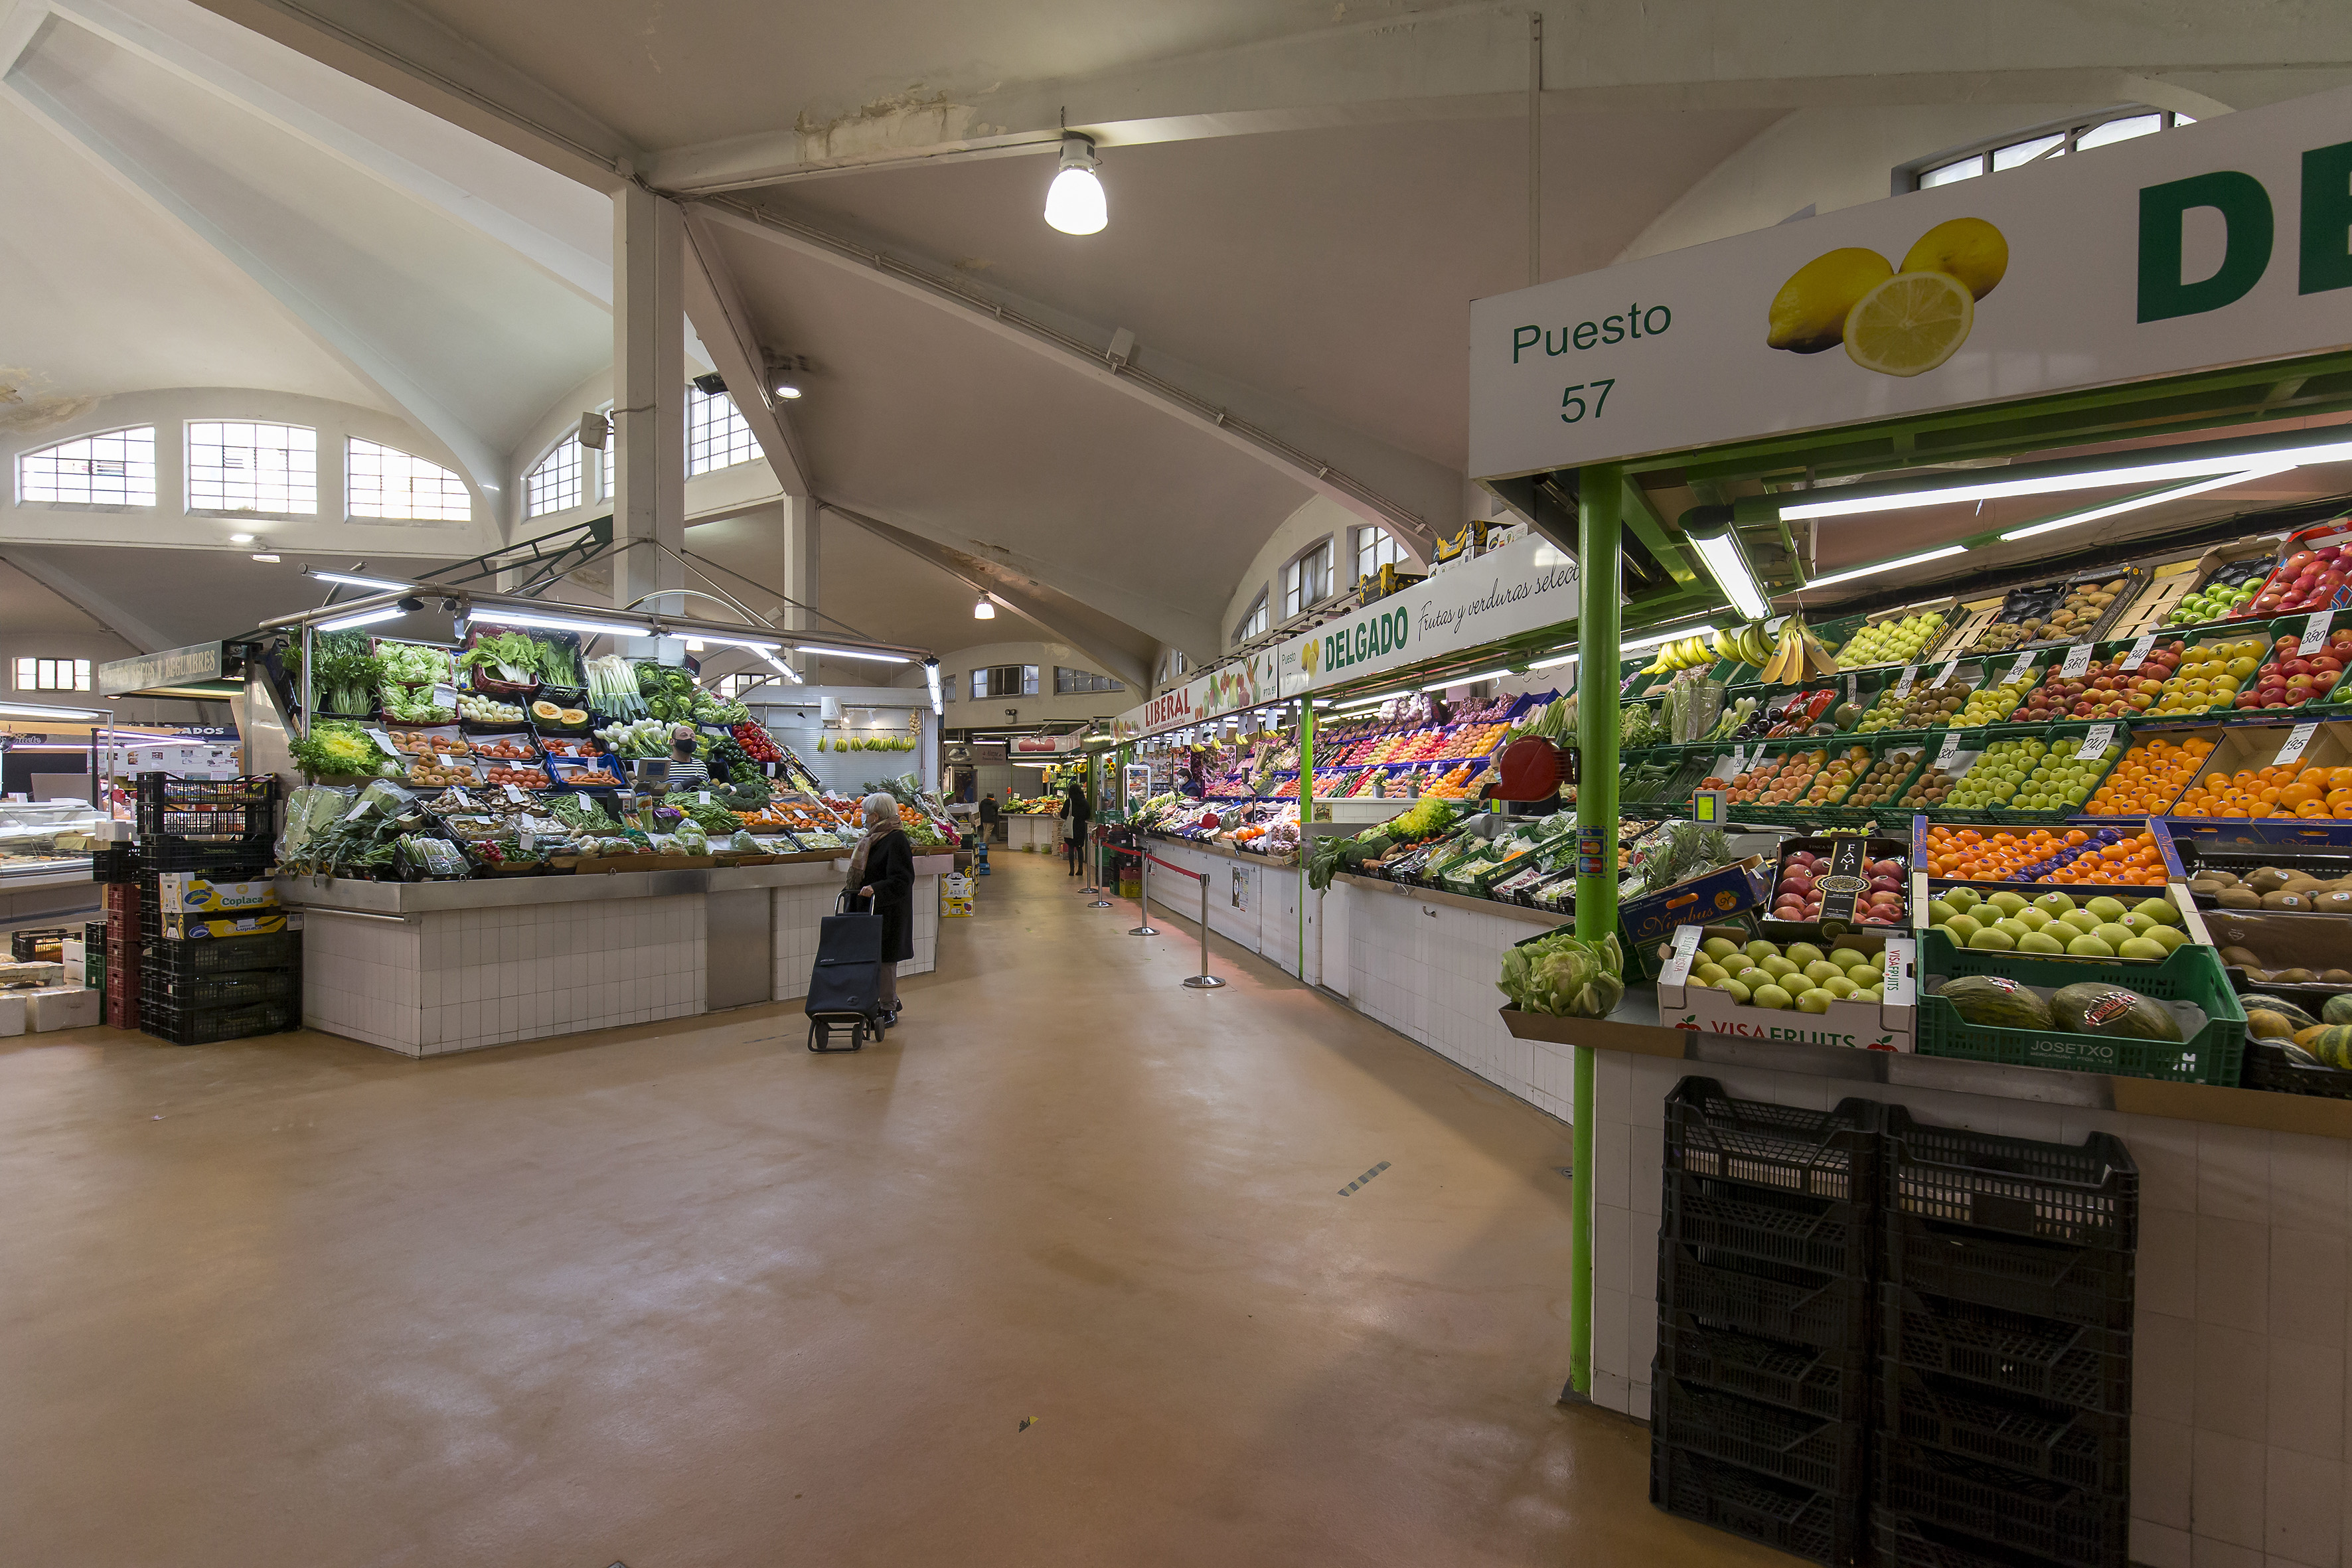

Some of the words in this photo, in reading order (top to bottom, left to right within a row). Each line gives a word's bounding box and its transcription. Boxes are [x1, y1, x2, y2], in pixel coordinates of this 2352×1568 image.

[1513, 301, 1672, 364] Puesto
[1560, 379, 1616, 425] 57
[1325, 605, 1409, 672] DELGADO
[1418, 600, 1455, 642] Frutas
[1454, 607, 1466, 634] y
[1466, 578, 1532, 617] verduras
[1534, 554, 1579, 595] select
[157, 660, 163, 679] Y
[166, 649, 216, 678] LEGUMBRES
[1282, 651, 1296, 666] Puesto
[1145, 688, 1191, 728] LIBERAL
[2080, 737, 2107, 751] 2'40
[2281, 736, 2308, 751] 1'95
[221, 896, 264, 907] Coplaca
[1637, 906, 1714, 937] Nimbus
[2031, 1040, 2114, 1058] JOSETXO
